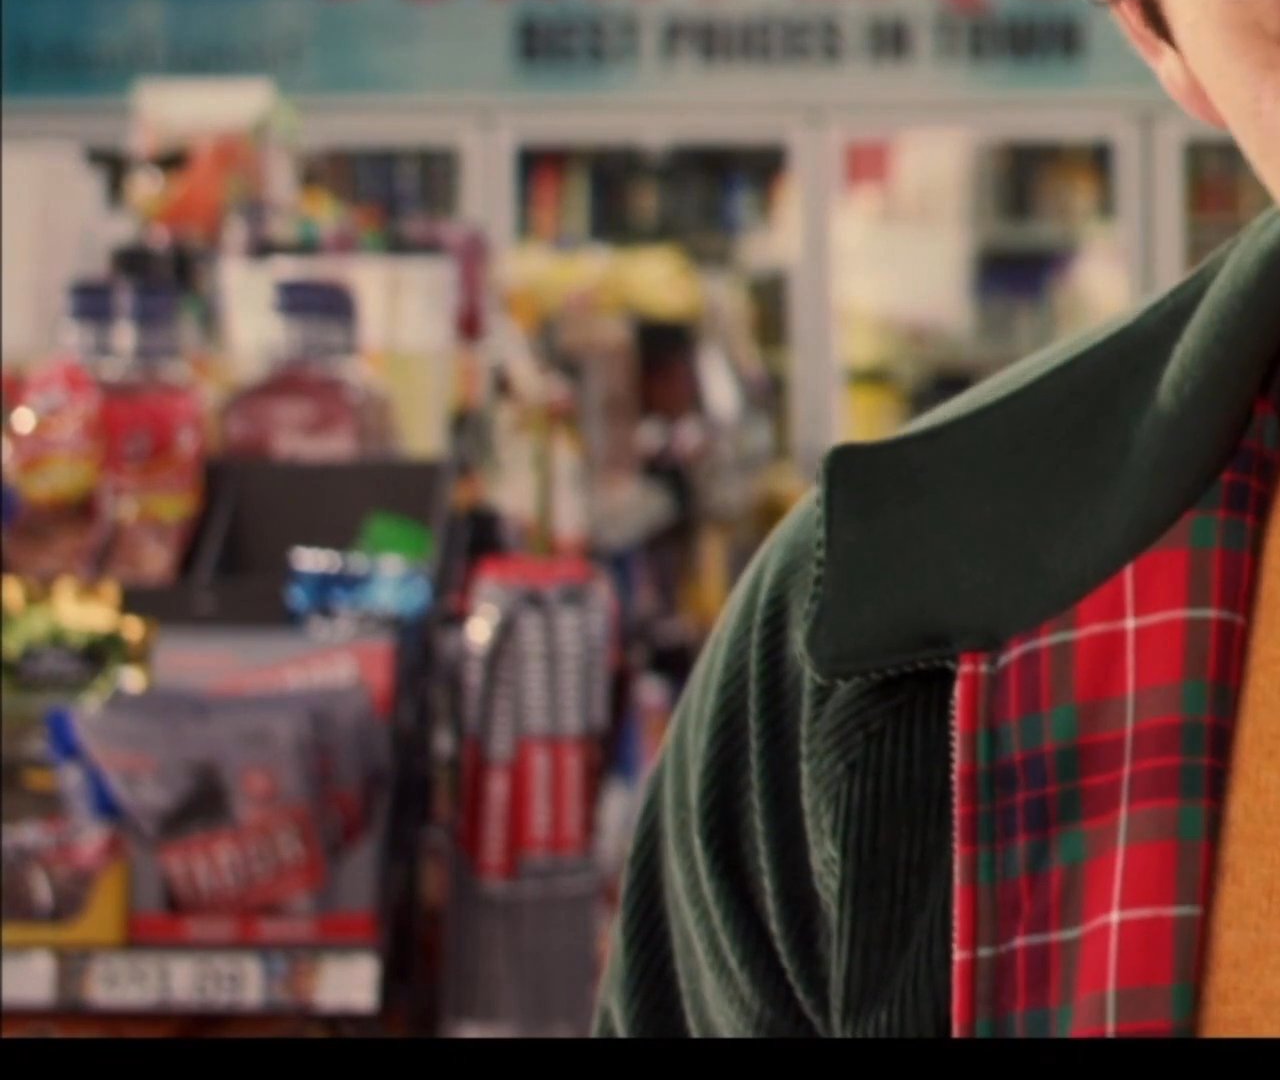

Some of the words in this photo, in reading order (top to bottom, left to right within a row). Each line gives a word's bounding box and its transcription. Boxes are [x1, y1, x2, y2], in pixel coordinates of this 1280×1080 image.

[517, 16, 636, 67] BEST
[662, 16, 844, 67] PRICES
[868, 18, 912, 66] IN
[936, 16, 1084, 67] TOWN
